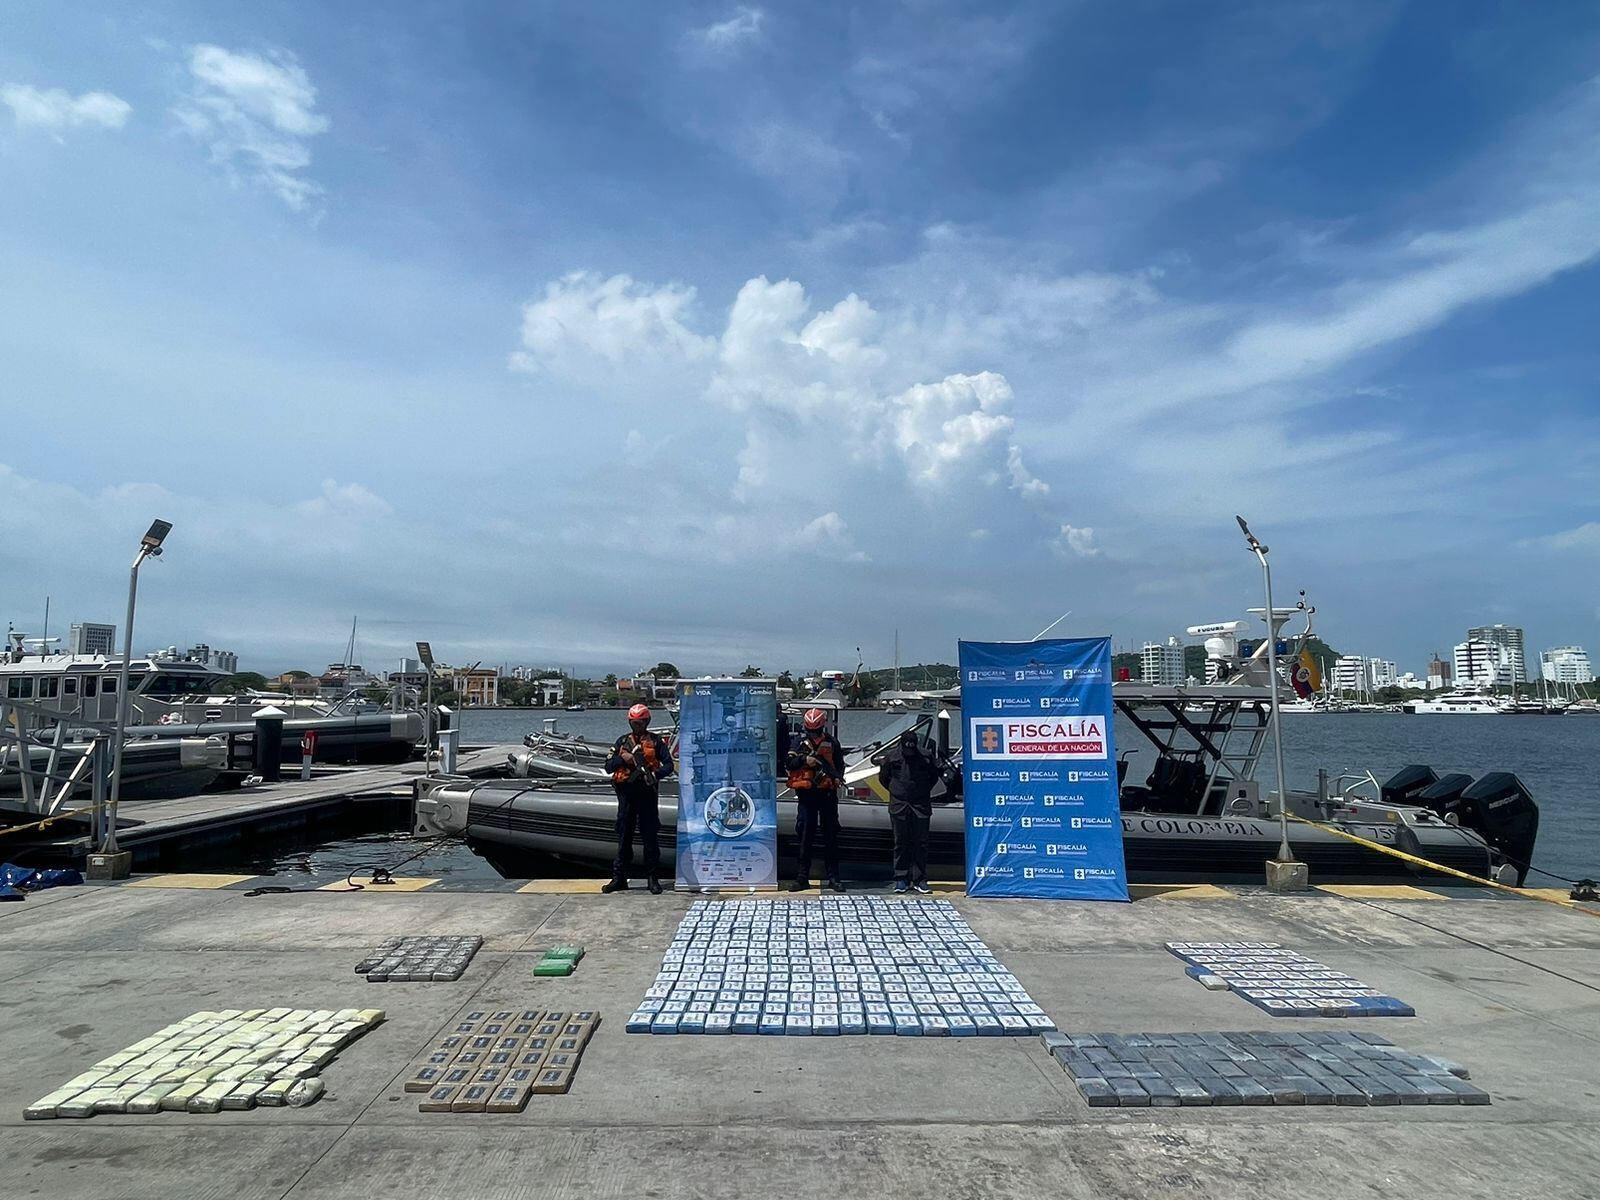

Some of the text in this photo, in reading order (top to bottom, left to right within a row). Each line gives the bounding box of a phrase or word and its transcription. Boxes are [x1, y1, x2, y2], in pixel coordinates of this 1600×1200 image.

[1008, 720, 1101, 738] FISCALÍA
[1011, 743, 1100, 752] GENERAL DE LA NACIÓN
[1140, 818, 1264, 836] COLOMBIA
